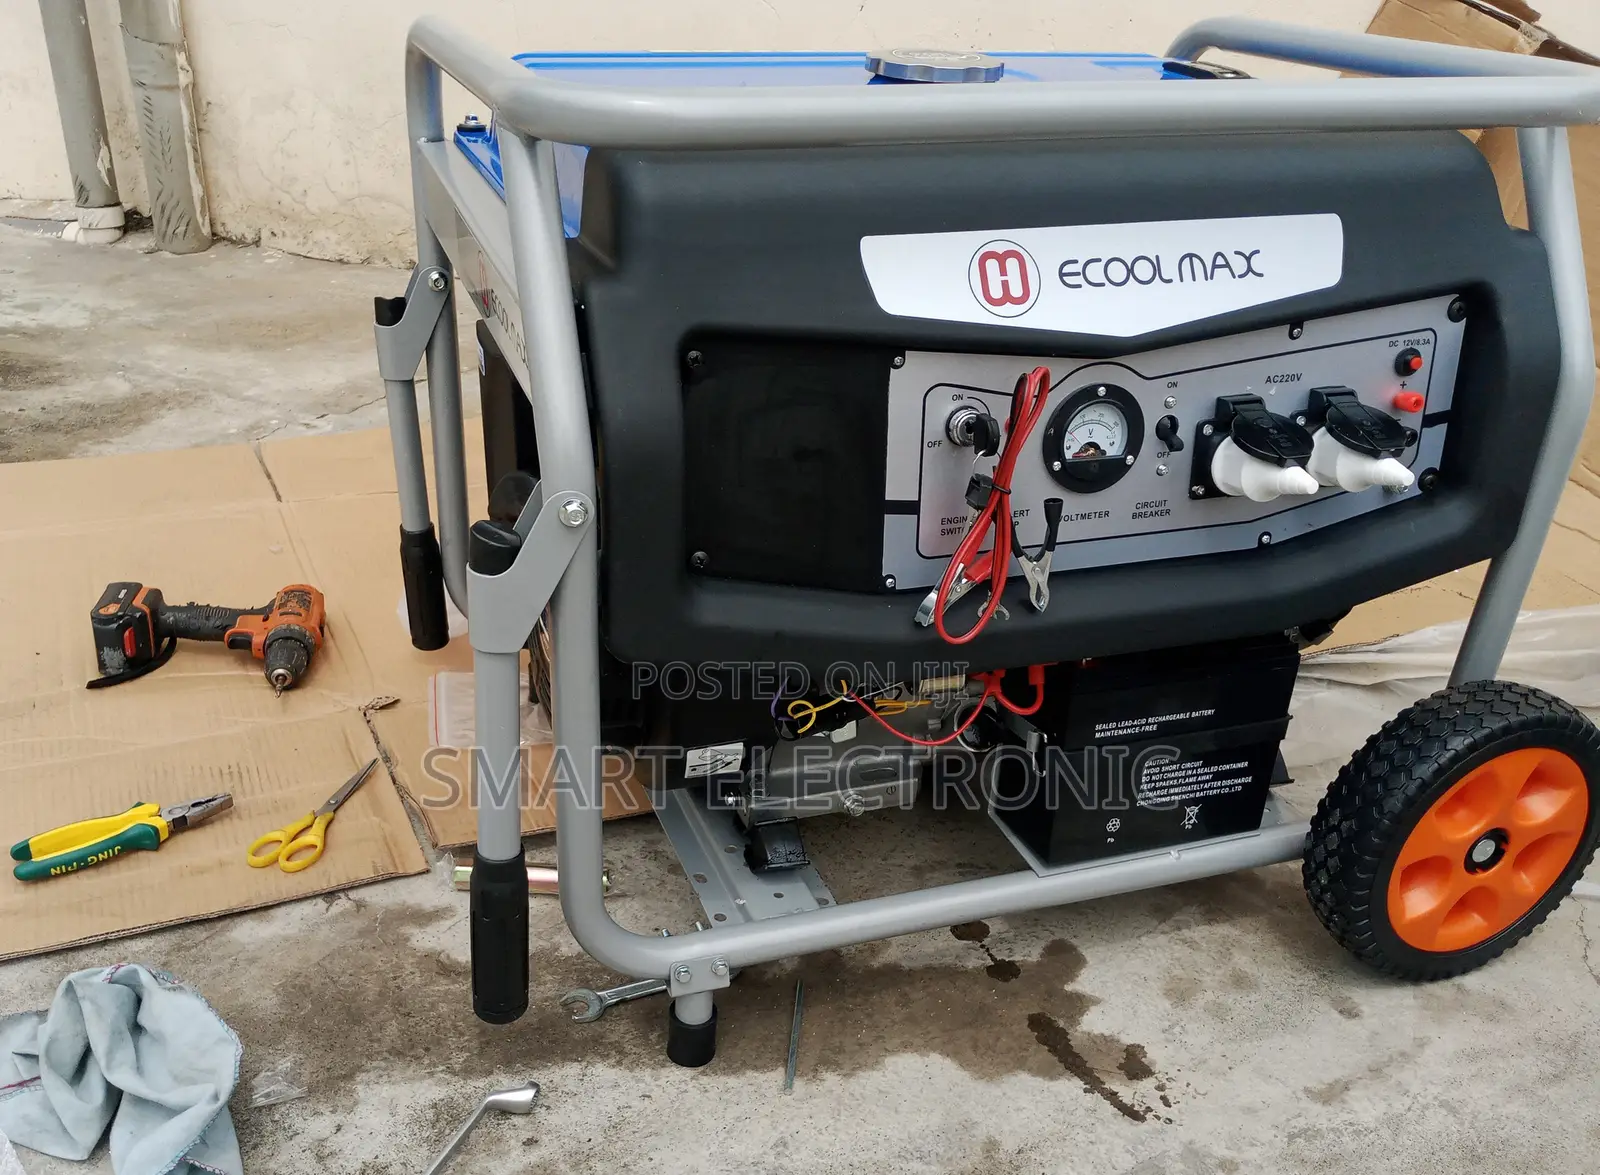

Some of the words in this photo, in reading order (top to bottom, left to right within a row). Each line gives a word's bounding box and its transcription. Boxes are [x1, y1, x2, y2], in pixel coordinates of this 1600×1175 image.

[1264, 372, 1303, 384] AC220V
[927, 440, 943, 448] OFF
[1156, 451, 1171, 459] OFF
[1135, 500, 1168, 510] CIRCUIT
[1013, 508, 1030, 518] ERT
[1131, 509, 1171, 520] BREAKER
[940, 515, 968, 526] ENGIN
[940, 527, 965, 536] SWIT
[1095, 721, 1117, 731] SEALED
[1118, 717, 1147, 728] LEAD-ACID
[1147, 712, 1190, 724] RECHARGEABLE
[1191, 708, 1216, 718] BATTERY
[1094, 724, 1158, 738] MAINTENANCE-FREE
[1143, 767, 1160, 775] AVOID
[1161, 764, 1181, 772] SHORT
[1181, 760, 1203, 769] CIRCUIT
[1151, 773, 1163, 781] NOT
[1163, 770, 1186, 779] CHARGE
[1197, 766, 1218, 774] SEALED
[1218, 761, 1249, 771] CONTAINER
[1137, 788, 1168, 799] RECHARGE
[1168, 783, 1204, 795] IMMEDIATELY
[1203, 780, 1222, 789] AFTER
[1221, 776, 1253, 786] DISCHARGE
[1140, 782, 1155, 790] KEEP
[1197, 774, 1214, 782] AWAY
[1195, 788, 1221, 798] BATTERY
